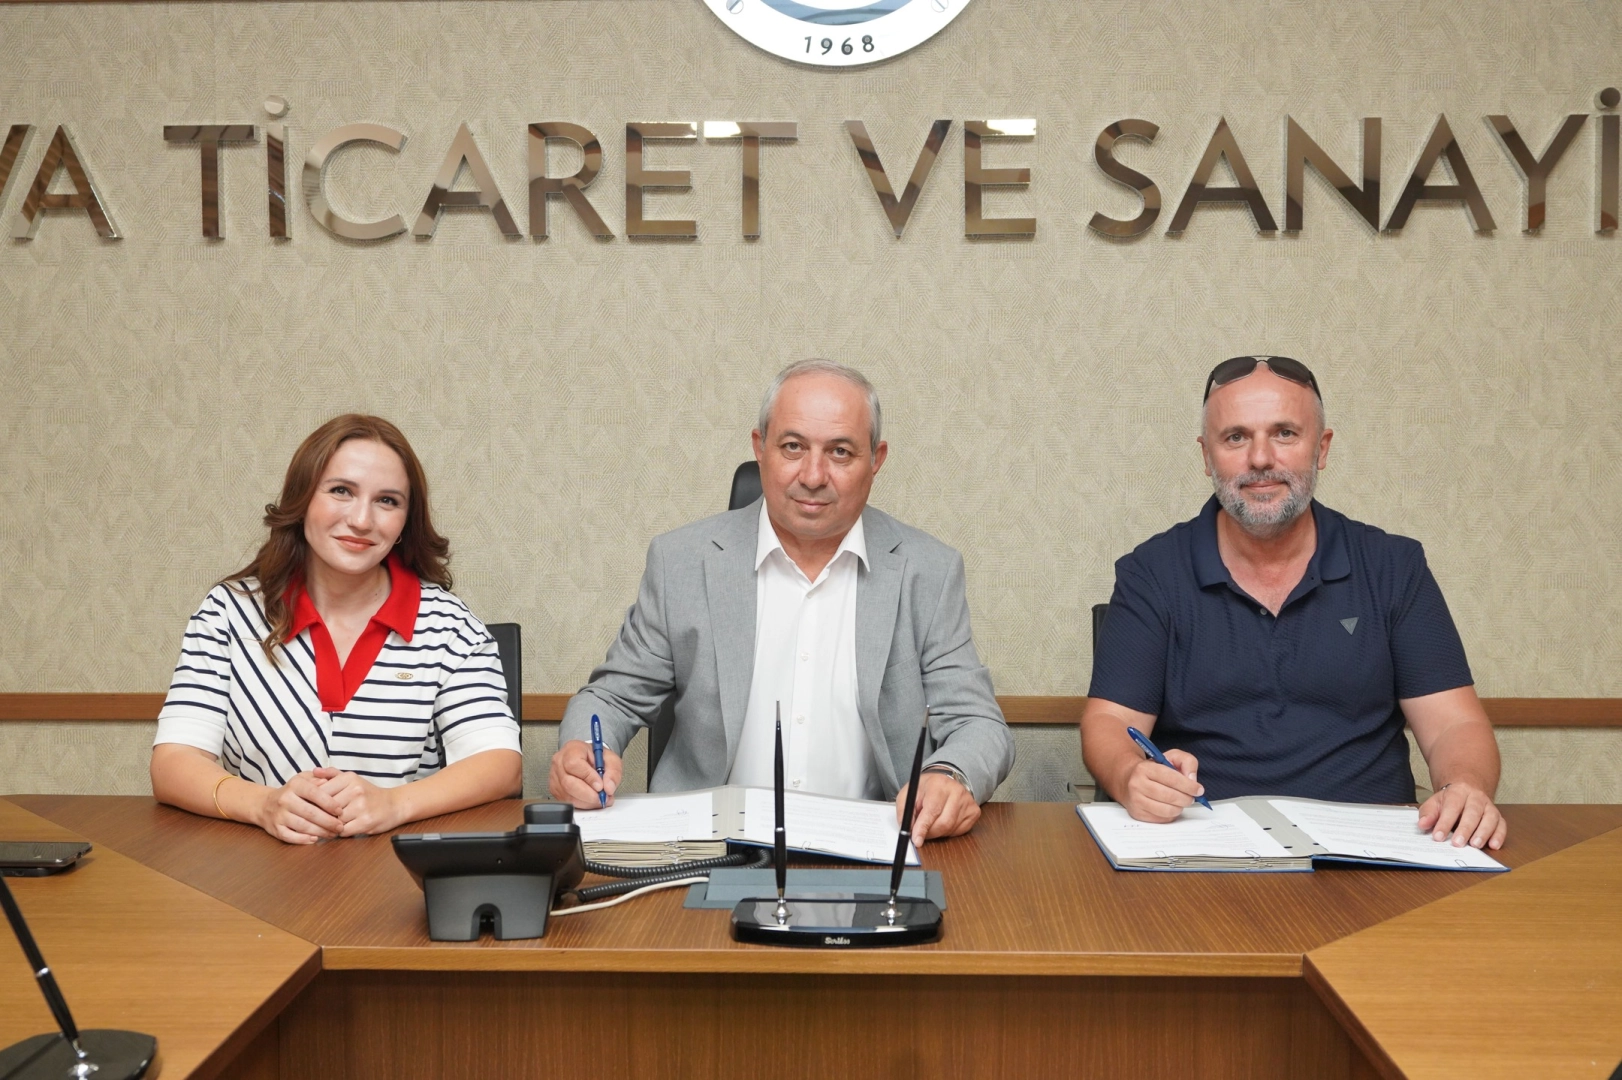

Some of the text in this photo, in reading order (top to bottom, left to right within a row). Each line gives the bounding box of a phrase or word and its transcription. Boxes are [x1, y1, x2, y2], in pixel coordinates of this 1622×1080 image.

[803, 34, 876, 56] 1968
[163, 95, 798, 242] TİCARET
[844, 117, 1037, 240] VE
[1088, 87, 1621, 240] SANAYİ
